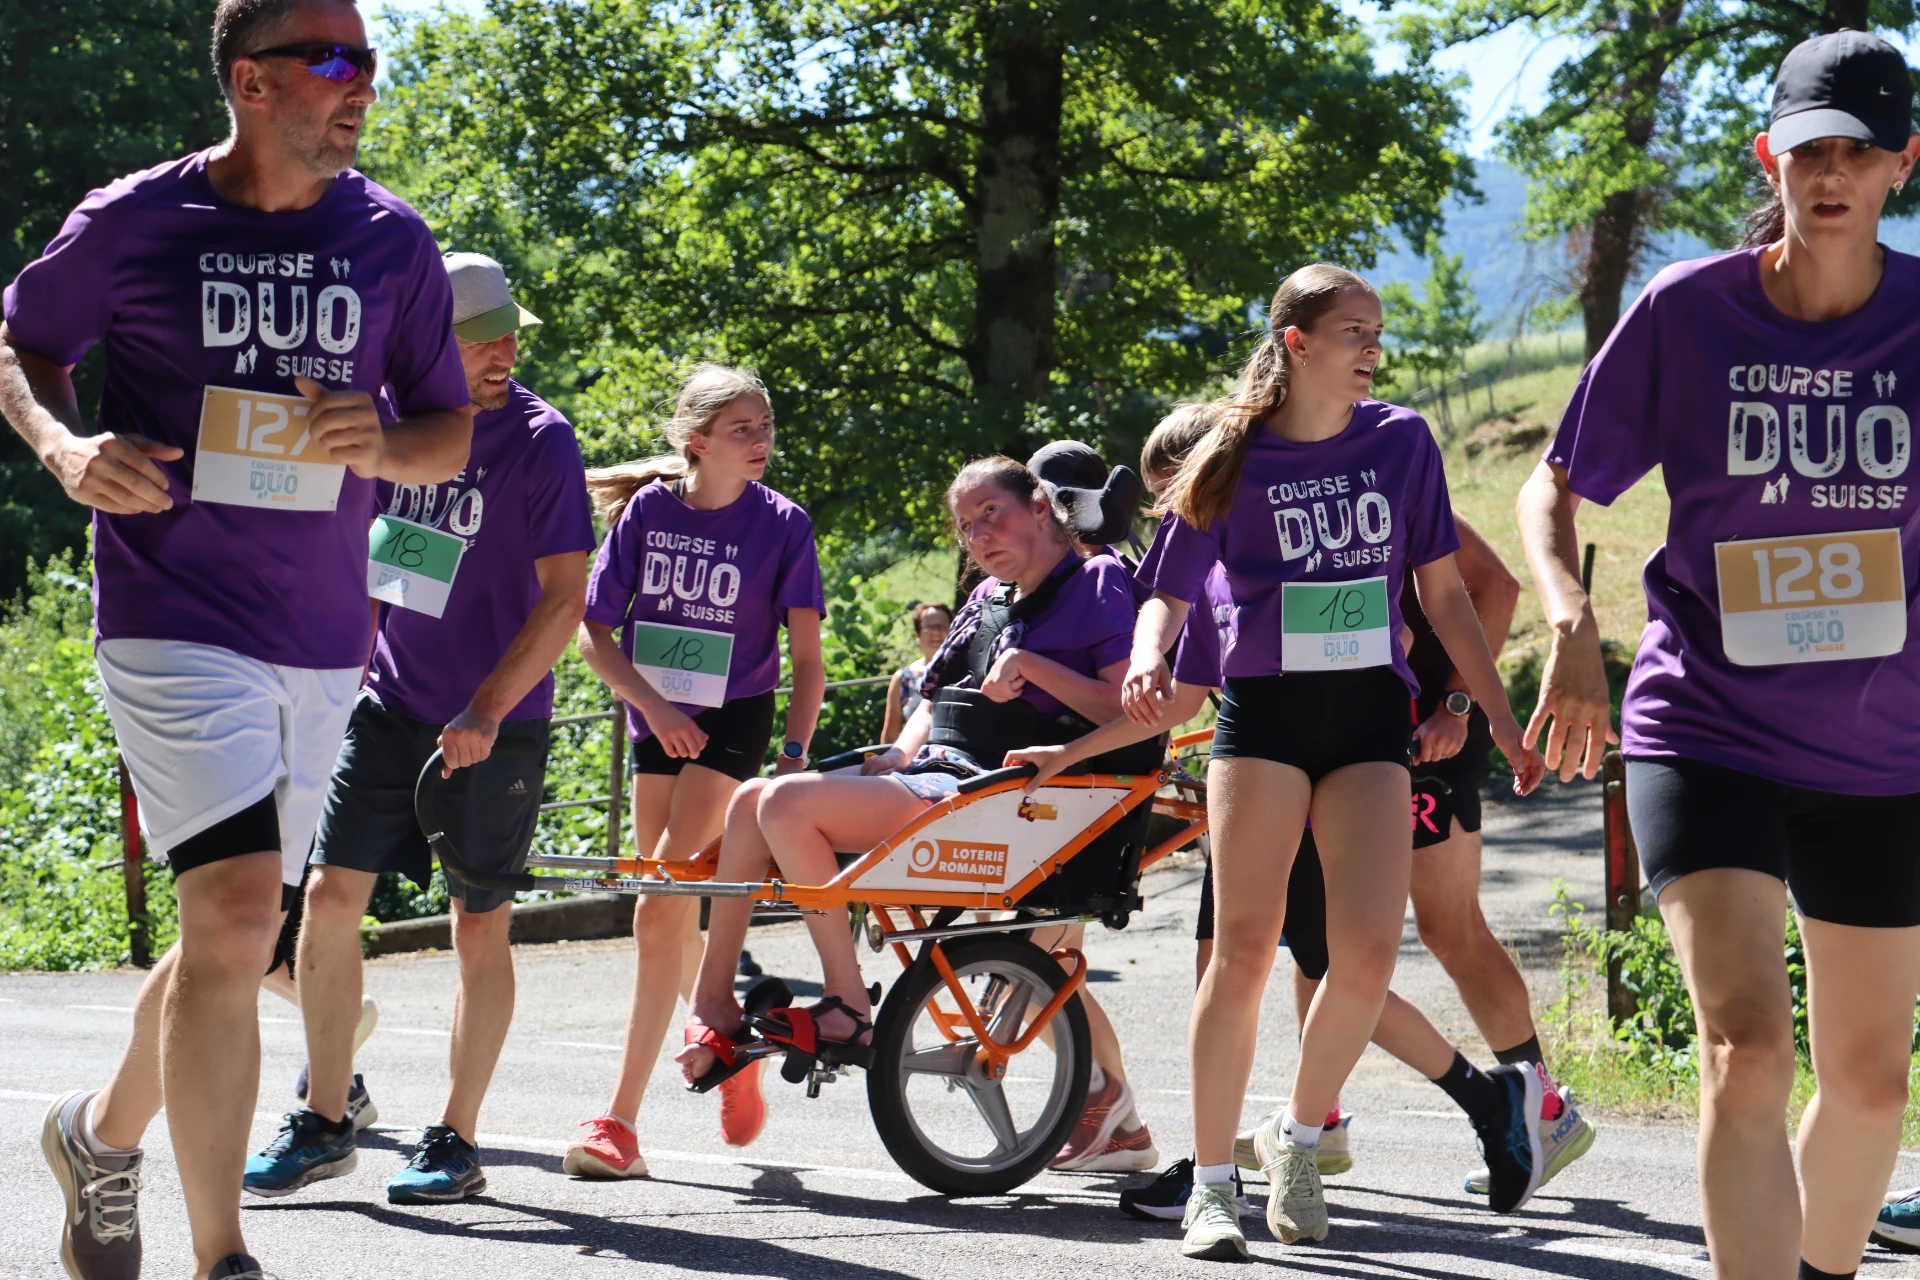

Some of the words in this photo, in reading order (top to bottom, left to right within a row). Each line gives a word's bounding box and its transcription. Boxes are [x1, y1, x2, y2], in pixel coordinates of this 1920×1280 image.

[200, 252, 314, 278] COURSE
[202, 280, 362, 354] DUO
[275, 355, 354, 383] SUISSE
[1729, 364, 1853, 397] COURSE
[1727, 401, 1911, 479] DUO
[251, 460, 287, 472] COURSE
[249, 470, 299, 495] DUO
[1267, 475, 1351, 504] COURSE
[387, 483, 484, 536] DUO
[1811, 485, 1908, 510] SUISSE
[1273, 492, 1392, 562] DUO
[386, 528, 428, 567] 18
[646, 530, 717, 556] COURSE
[1333, 545, 1392, 569] SUISSE
[642, 551, 741, 607] DUO
[1753, 542, 1864, 605] 128
[682, 602, 736, 624] SUISSE
[1319, 588, 1366, 631] 18
[1785, 609, 1825, 621] COURSE
[1323, 633, 1350, 641] COURSE
[1786, 619, 1845, 645] DUO
[660, 636, 704, 671] 18
[1323, 640, 1360, 657] DUO
[1815, 643, 1845, 653] SUISSE
[661, 675, 693, 691] DUO
[952, 847, 1005, 862] LOTERIE
[939, 861, 1003, 876] ROMANDE
[1551, 1109, 1580, 1144] HOKA
